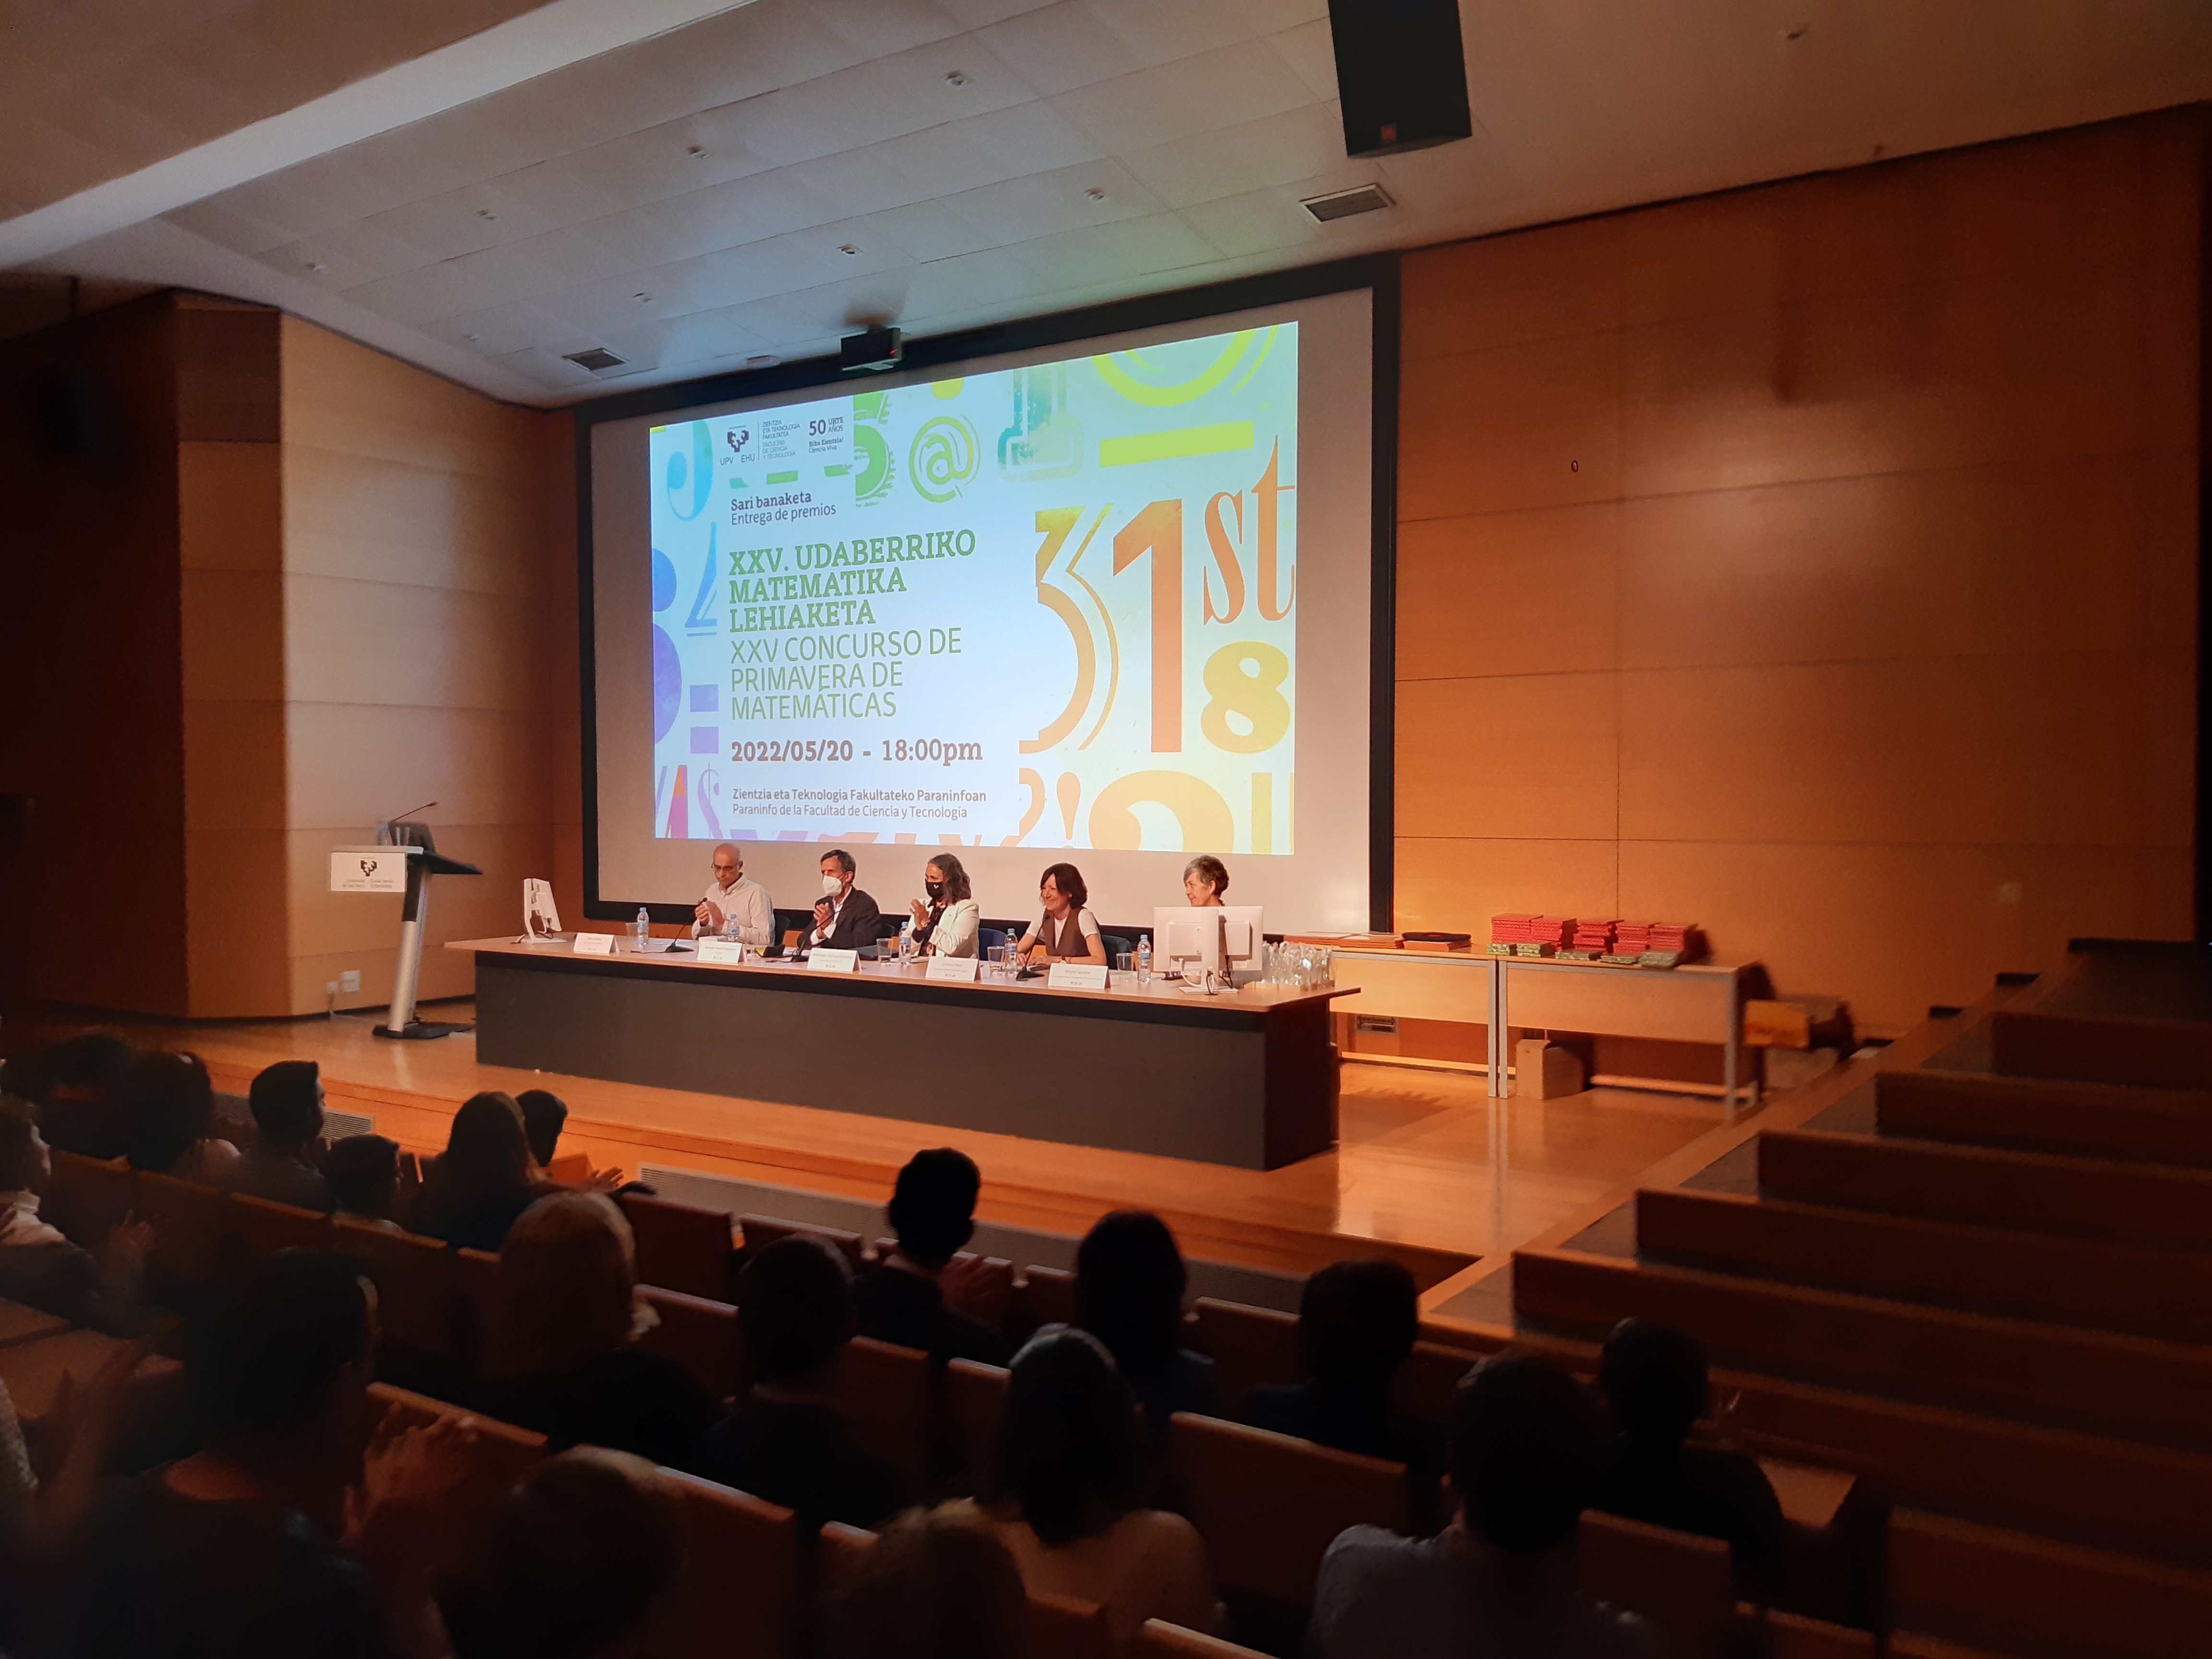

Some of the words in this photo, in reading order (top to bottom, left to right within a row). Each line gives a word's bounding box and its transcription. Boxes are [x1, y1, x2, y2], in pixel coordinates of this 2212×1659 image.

[762, 420, 782, 428] ZIENTZIA
[771, 423, 801, 432] TEKNOLOGIA
[809, 419, 826, 436] 50
[828, 417, 844, 425] URTE
[828, 424, 844, 433] AÑOS
[762, 431, 790, 440] FAKULTATEA
[821, 437, 844, 445] Zientzia!
[720, 457, 734, 466] UPV
[741, 453, 755, 463] EHU
[731, 496, 754, 511] Sari
[756, 492, 812, 508] banaketa
[732, 512, 772, 526] Entrega
[775, 508, 788, 521] de
[792, 503, 836, 522] premios
[729, 547, 789, 576] XXV.
[795, 529, 976, 570] UDABERRIKO
[729, 566, 907, 604] MATEMATIKA
[730, 599, 876, 633] LEHIAKETA
[730, 638, 779, 664] XXV
[784, 630, 922, 662] CONCURSO
[929, 627, 962, 655] DE
[732, 662, 866, 692] PRIMAVERA
[872, 661, 903, 688] DE
[732, 685, 897, 721] MATEMÁTICAS
[731, 739, 853, 762] 2022/05/20
[882, 738, 983, 767] 18:00pm
[733, 788, 772, 800] Zientzia
[774, 789, 790, 800] eta
[792, 789, 848, 803] Teknologia
[850, 789, 914, 801] Fakultateko
[917, 790, 986, 802] Paraninfoan
[733, 804, 778, 815] Paraninfo
[779, 804, 791, 815] de
[793, 804, 802, 815] la
[804, 805, 845, 816] Facultad
[848, 805, 860, 816] de
[863, 805, 899, 817] Ciencia
[902, 808, 907, 819] y
[909, 805, 967, 821] Tecnología
